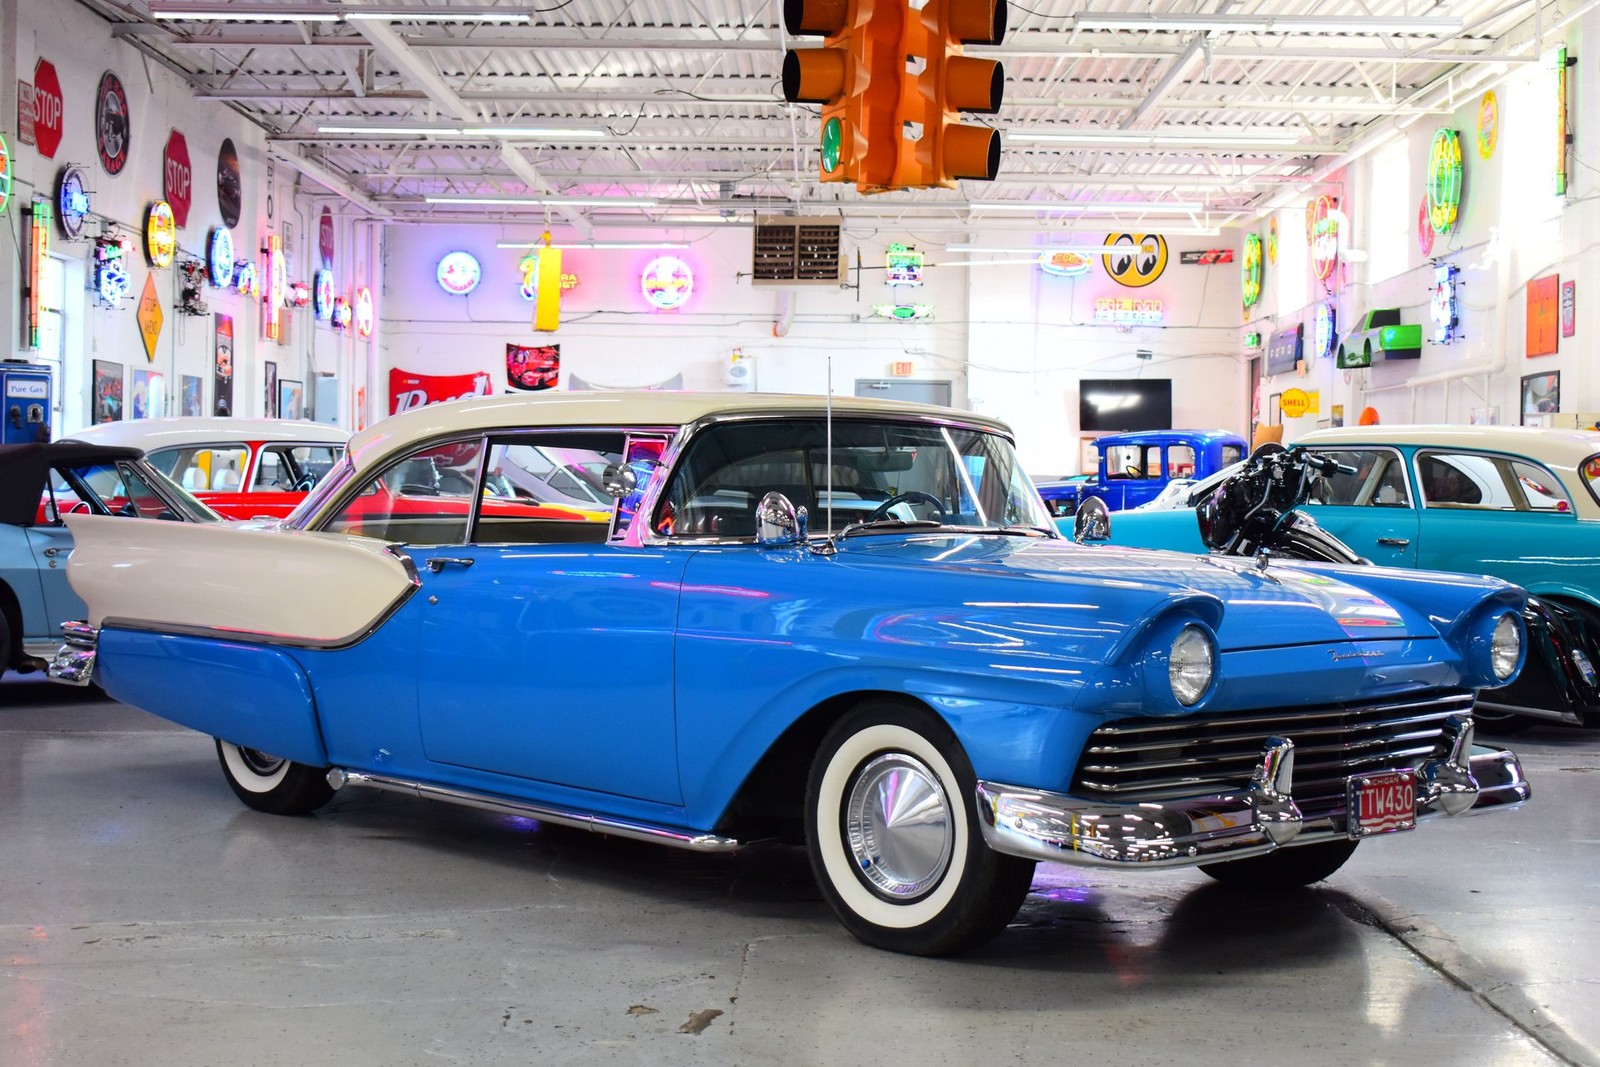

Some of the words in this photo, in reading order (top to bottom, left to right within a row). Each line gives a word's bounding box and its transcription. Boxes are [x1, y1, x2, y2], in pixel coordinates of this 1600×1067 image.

[33, 86, 61, 130] STOP
[167, 157, 190, 200] STOP
[896, 361, 912, 375] EXIT
[11, 385, 27, 393] Pure
[29, 385, 43, 393] Gas
[1282, 398, 1306, 407] SHELL
[1367, 775, 1400, 787] ICHIGAN
[1356, 784, 1413, 817] TTW430
